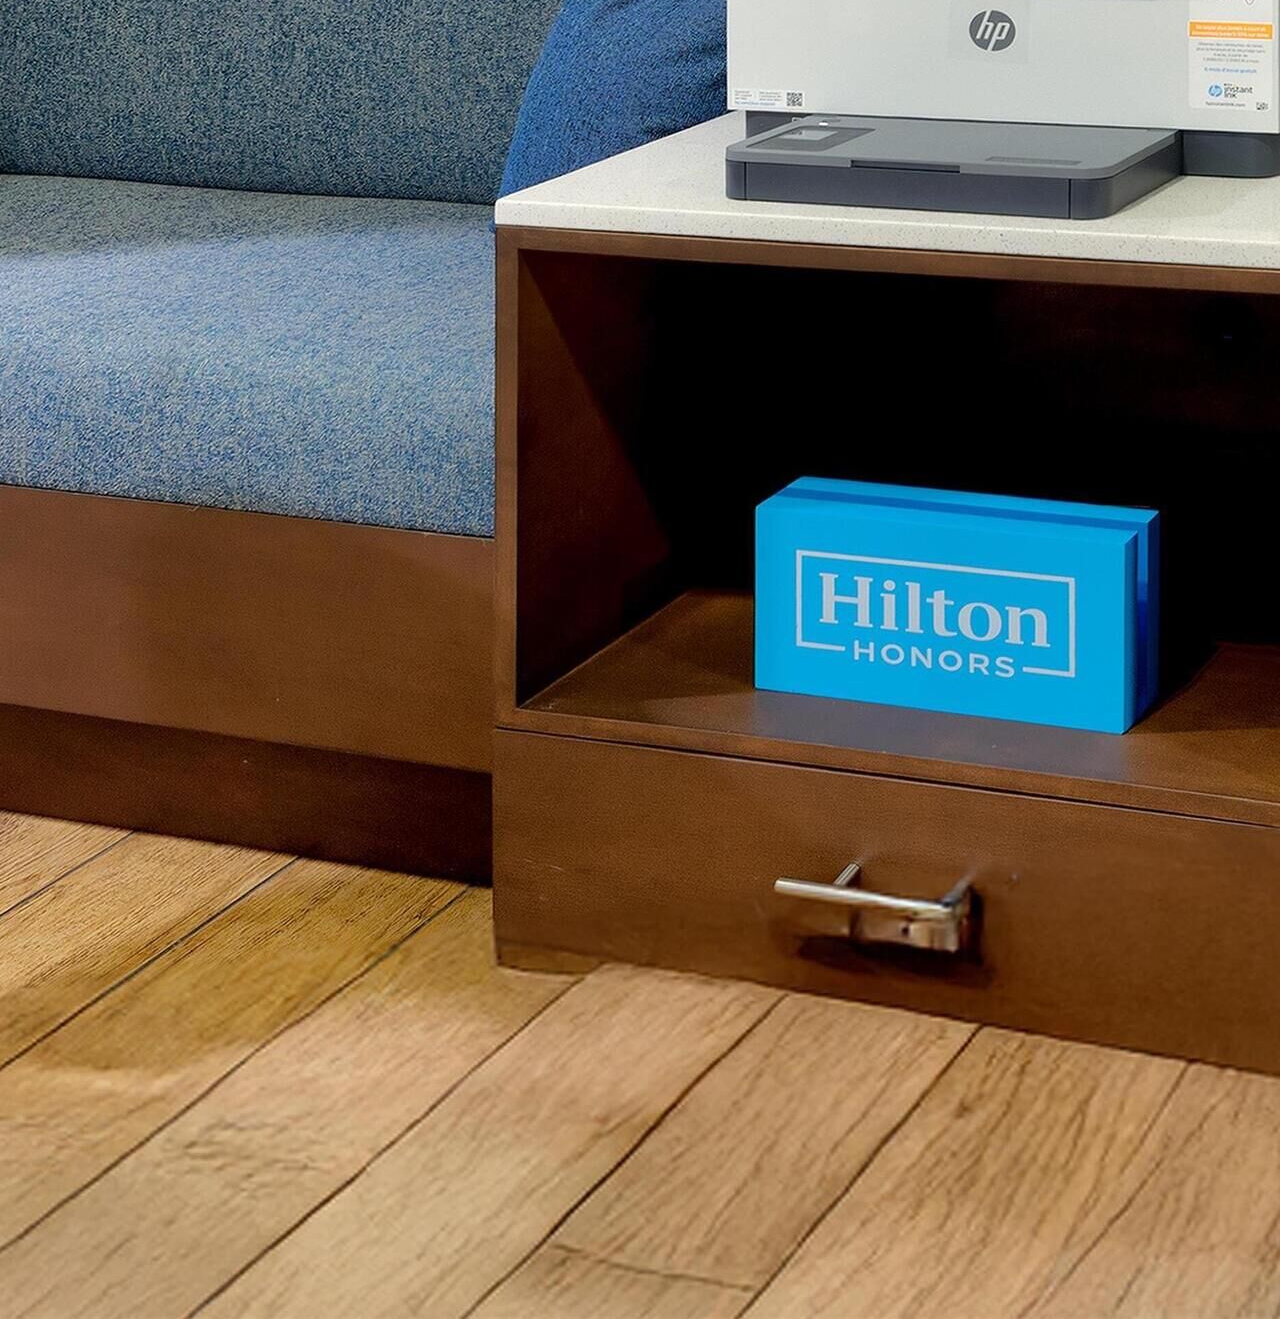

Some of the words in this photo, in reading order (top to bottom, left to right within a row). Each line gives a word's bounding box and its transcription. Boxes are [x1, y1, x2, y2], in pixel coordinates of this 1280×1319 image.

[974, 9, 1012, 52] hp
[819, 572, 1051, 647] Hilton
[854, 640, 1015, 679] HONORS
